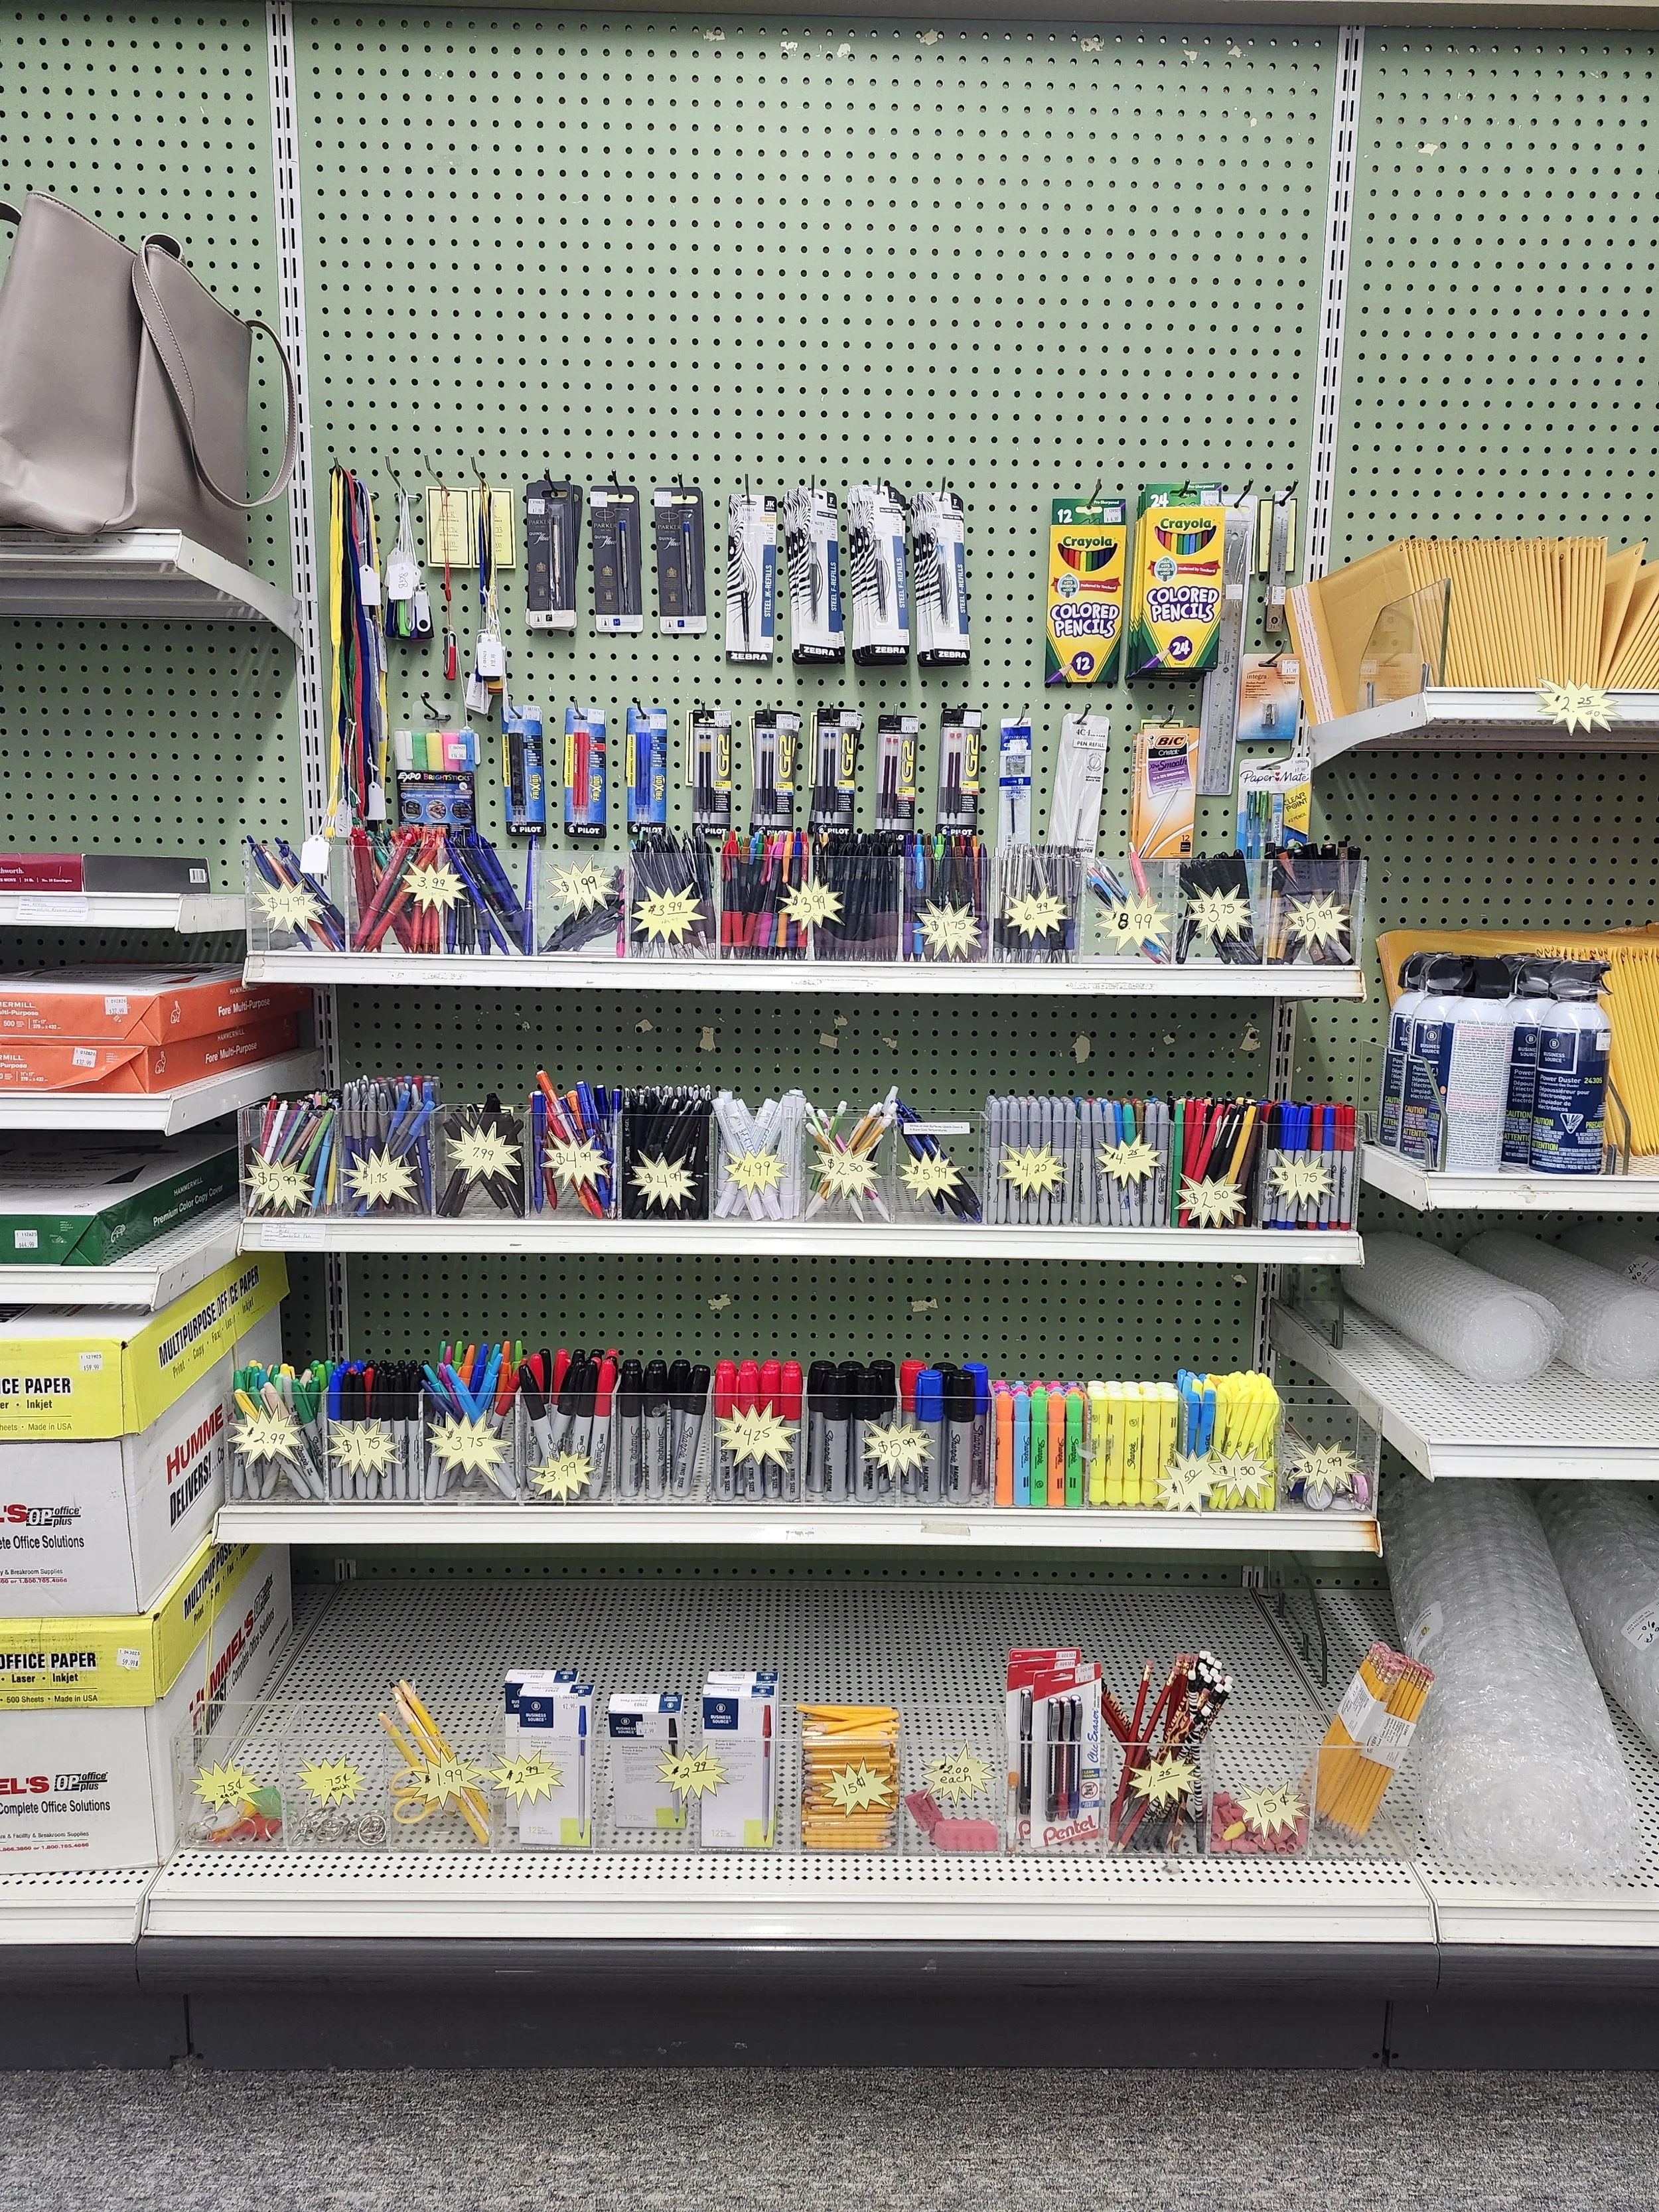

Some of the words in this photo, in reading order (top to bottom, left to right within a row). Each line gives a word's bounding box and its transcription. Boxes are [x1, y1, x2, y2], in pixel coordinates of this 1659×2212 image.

[1151, 493, 1169, 507] 24
[1057, 509, 1073, 524] 12
[1160, 518, 1212, 531] Crayola
[1062, 536, 1113, 549] Crayola
[1149, 587, 1218, 605] COLORED
[1051, 603, 1119, 621] COLORED
[1151, 604, 1214, 623] PENCILS
[1055, 619, 1114, 637] PENCILS
[804, 646, 835, 657] ZEBRA
[938, 650, 967, 659] ZEBRA
[1172, 640, 1190, 654] 24
[731, 652, 768, 661] ZEBRA
[1076, 656, 1090, 670] 12
[1554, 695, 1594, 712] $2.25
[717, 734, 729, 776] G2
[778, 735, 792, 778] G2
[841, 733, 854, 776] G2
[901, 739, 914, 782] G2
[965, 734, 978, 777] G2
[1159, 757, 1188, 771] Smooth
[397, 772, 421, 782] EXPO
[1240, 771, 1275, 783] Paper
[1279, 772, 1309, 782] Mate
[1286, 798, 1308, 811] POINT
[561, 875, 598, 895] $1.99
[267, 896, 305, 917] $4.99
[791, 895, 826, 913] $3.99
[1023, 902, 1050, 921] 6.99
[1197, 902, 1236, 923] $3.75
[1112, 911, 1152, 930] $8.99
[1297, 909, 1334, 932] $5.99
[232, 997, 271, 1014] Multi-Purpose
[220, 1041, 257, 1059] Multi-Purpose
[1404, 1104, 1427, 1114] CAUTION
[1538, 1098, 1563, 1107] Limpiador
[1534, 1118, 1554, 1126] CAUTION
[472, 1146, 494, 1161] 7.99
[1532, 1140, 1558, 1151] ATTENTION
[556, 1151, 593, 1169] $4.99
[1109, 1148, 1139, 1166] $4.25
[827, 1159, 863, 1176] $2.50
[912, 1166, 948, 1181] $5.99
[258, 1171, 297, 1192] $5.99
[644, 1171, 682, 1189] $4.99
[1281, 1169, 1318, 1188] $1.75
[1189, 1190, 1230, 1209] $2.50
[153, 1207, 179, 1227] Premium
[179, 1199, 194, 1216] Color
[159, 1303, 217, 1369] MULTIPURPOSE
[239, 1264, 259, 1295] PAPER
[25, 1377, 71, 1394] PAPER
[27, 1399, 52, 1411] Inkjet
[28, 1423, 47, 1432] Made
[56, 1423, 72, 1432] USA
[736, 1424, 771, 1446] $4.25
[166, 1403, 224, 1485] HUMME
[247, 1428, 286, 1445] $2.99
[446, 1430, 488, 1451] $3.75
[342, 1437, 381, 1457] $1.75
[877, 1438, 917, 1457] $5.99
[1126, 1439, 1137, 1471] Sharpie
[541, 1461, 577, 1484] $3.99
[1304, 1456, 1342, 1475] $2.99
[950, 1466, 960, 1491] MAGNUM
[54, 1506, 80, 1517] office
[53, 1516, 73, 1528] plus
[13, 1534, 40, 1550] Office
[41, 1534, 85, 1549] Solutions
[50, 1652, 97, 1668] PAPER
[11, 1674, 35, 1684] Laser
[52, 1672, 79, 1684] Inkjet
[7, 1695, 21, 1704] 500
[21, 1694, 44, 1704] Sheets
[54, 1694, 72, 1703] Made
[83, 1694, 98, 1703] USA
[1087, 1710, 1100, 1742] Eraser
[82, 1772, 107, 1781] office
[425, 1769, 464, 1786] $1.99
[940, 1773, 972, 1785] each
[80, 1782, 100, 1792] plus
[41, 1801, 68, 1813] Office
[69, 1801, 111, 1812] Solutions
[1043, 1814, 1096, 1847] Pentel
